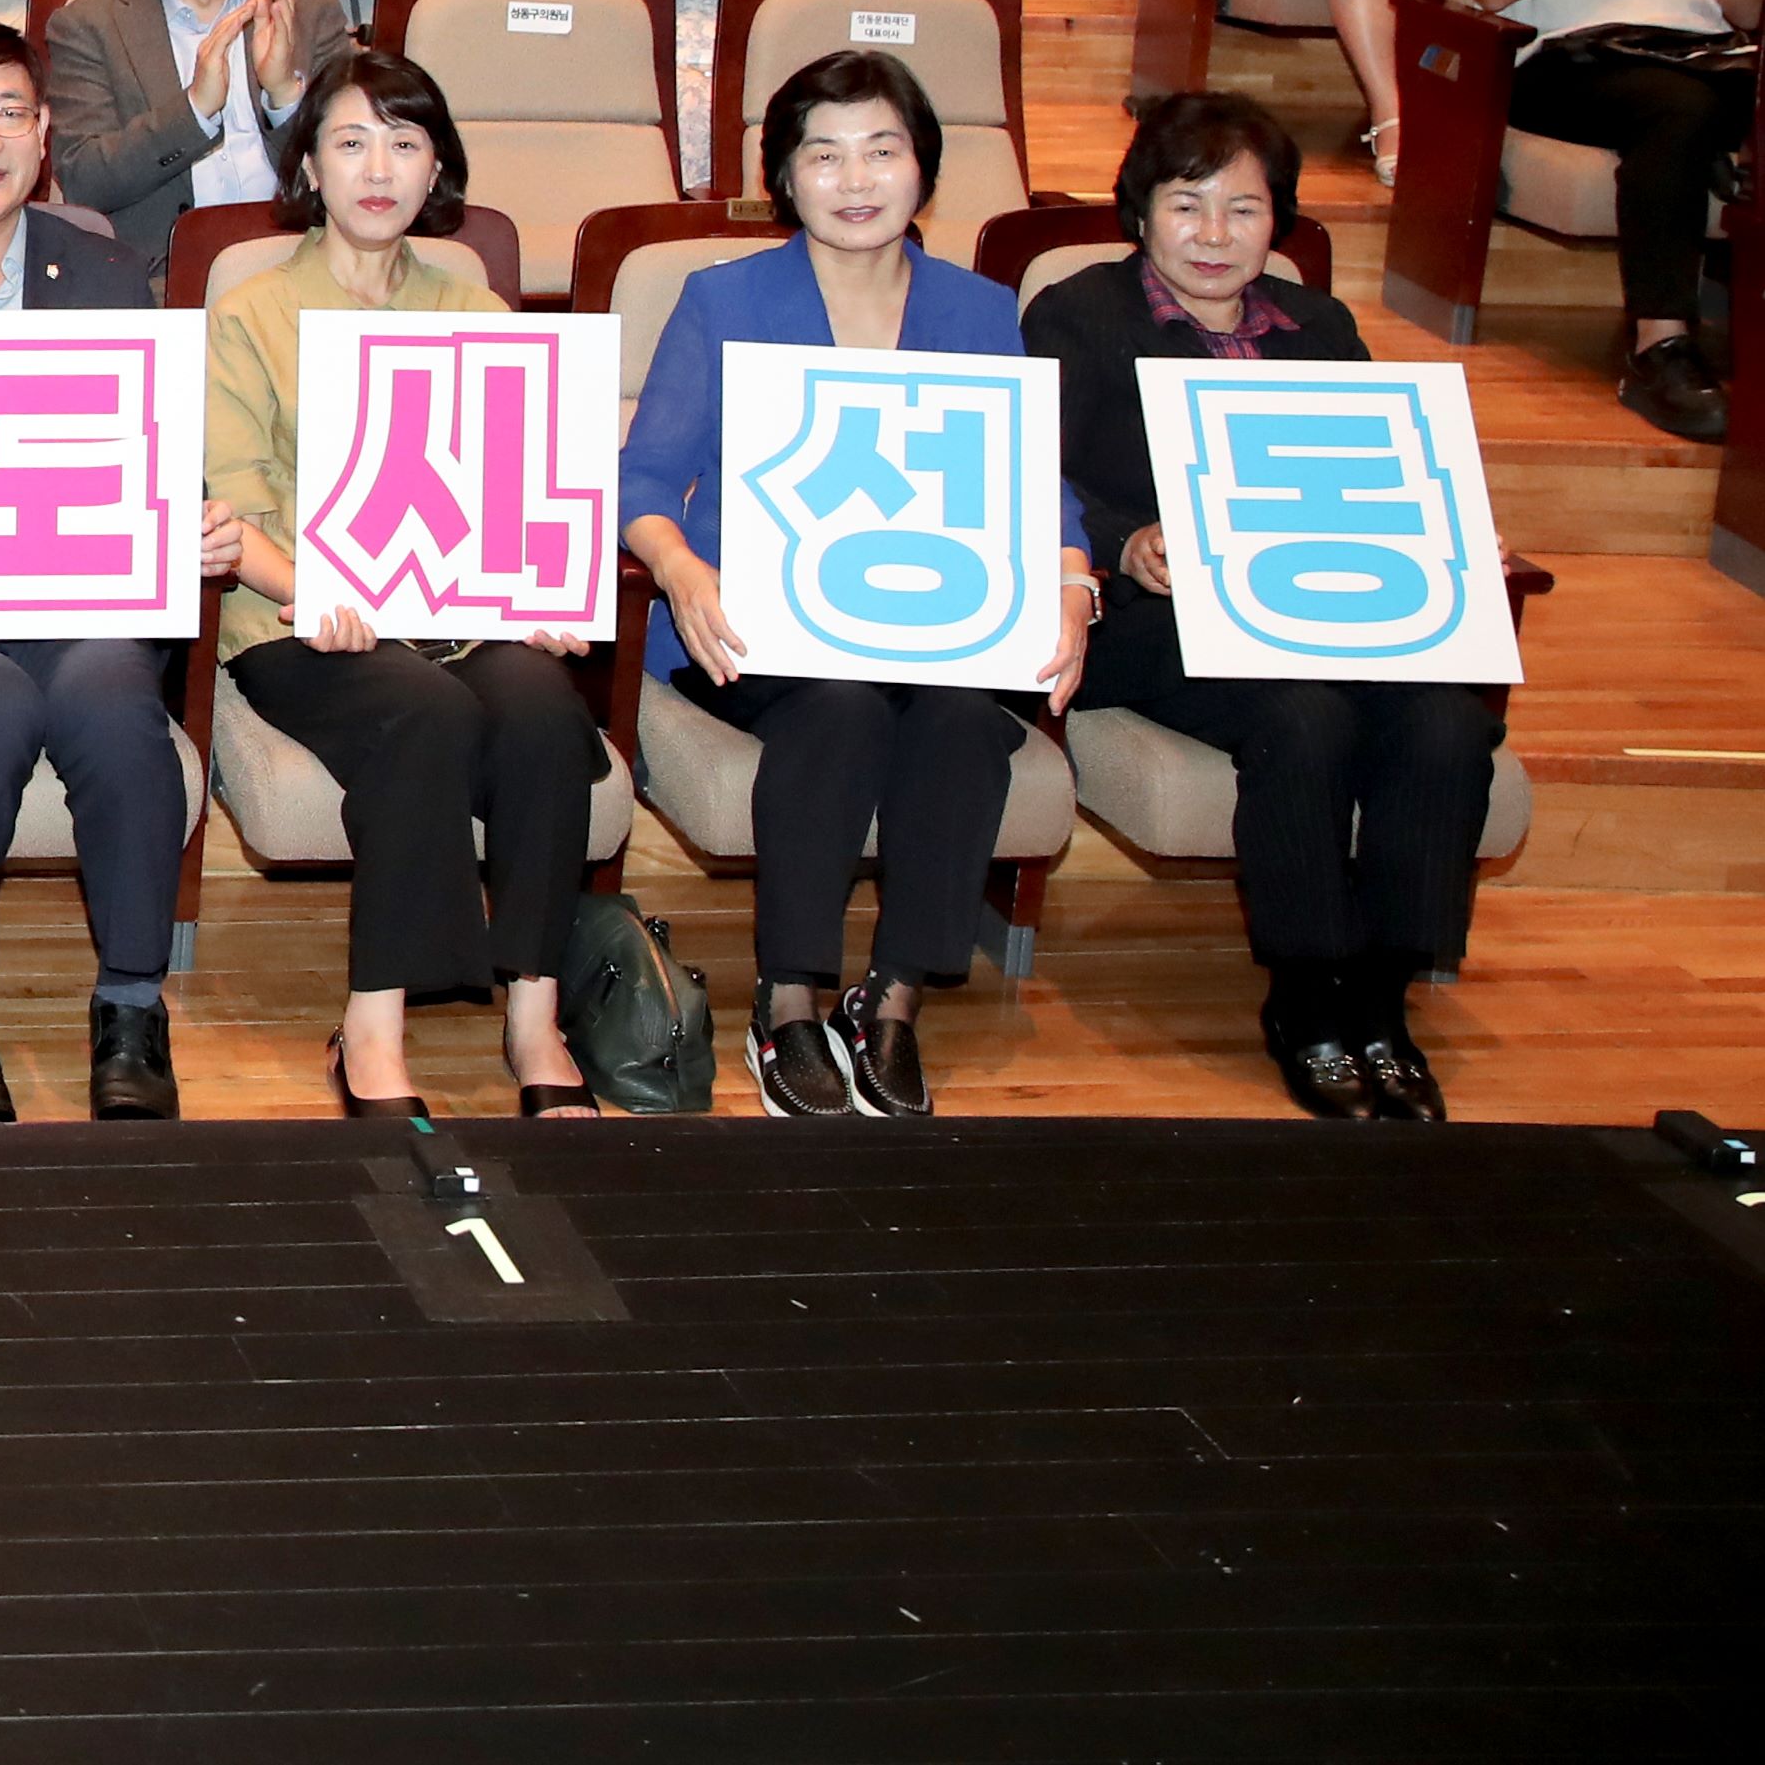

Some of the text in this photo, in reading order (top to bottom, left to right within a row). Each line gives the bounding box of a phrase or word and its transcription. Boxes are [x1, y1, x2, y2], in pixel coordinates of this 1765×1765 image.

[510, 7, 570, 23] 성동구의원님
[856, 14, 910, 26] 성동문화재단
[864, 28, 900, 40] 대표이사
[741, 369, 1025, 662] 성
[1185, 380, 1470, 658] 동
[444, 1217, 526, 1285] 1
